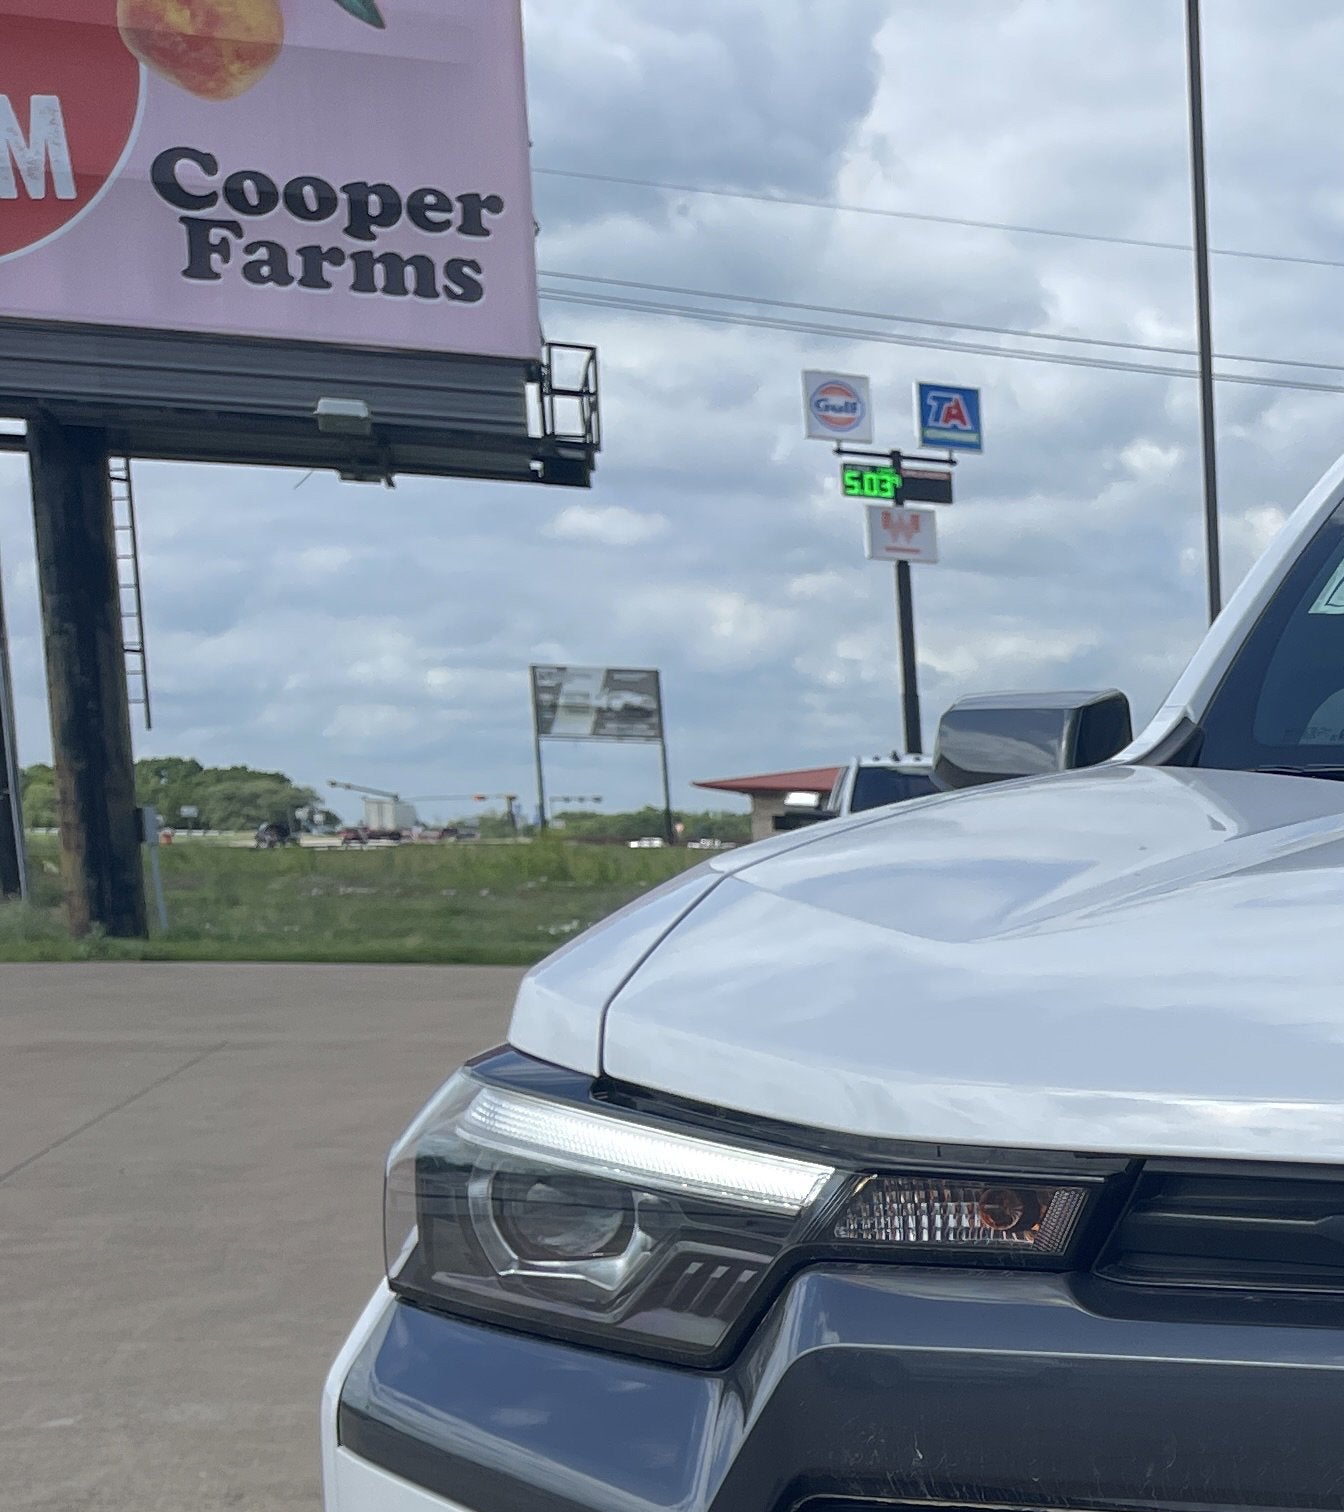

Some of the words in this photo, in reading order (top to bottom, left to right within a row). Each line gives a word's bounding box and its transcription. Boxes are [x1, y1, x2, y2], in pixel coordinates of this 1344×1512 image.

[151, 147, 504, 241] Cooper
[179, 216, 484, 302] Farms
[926, 390, 973, 430] TA
